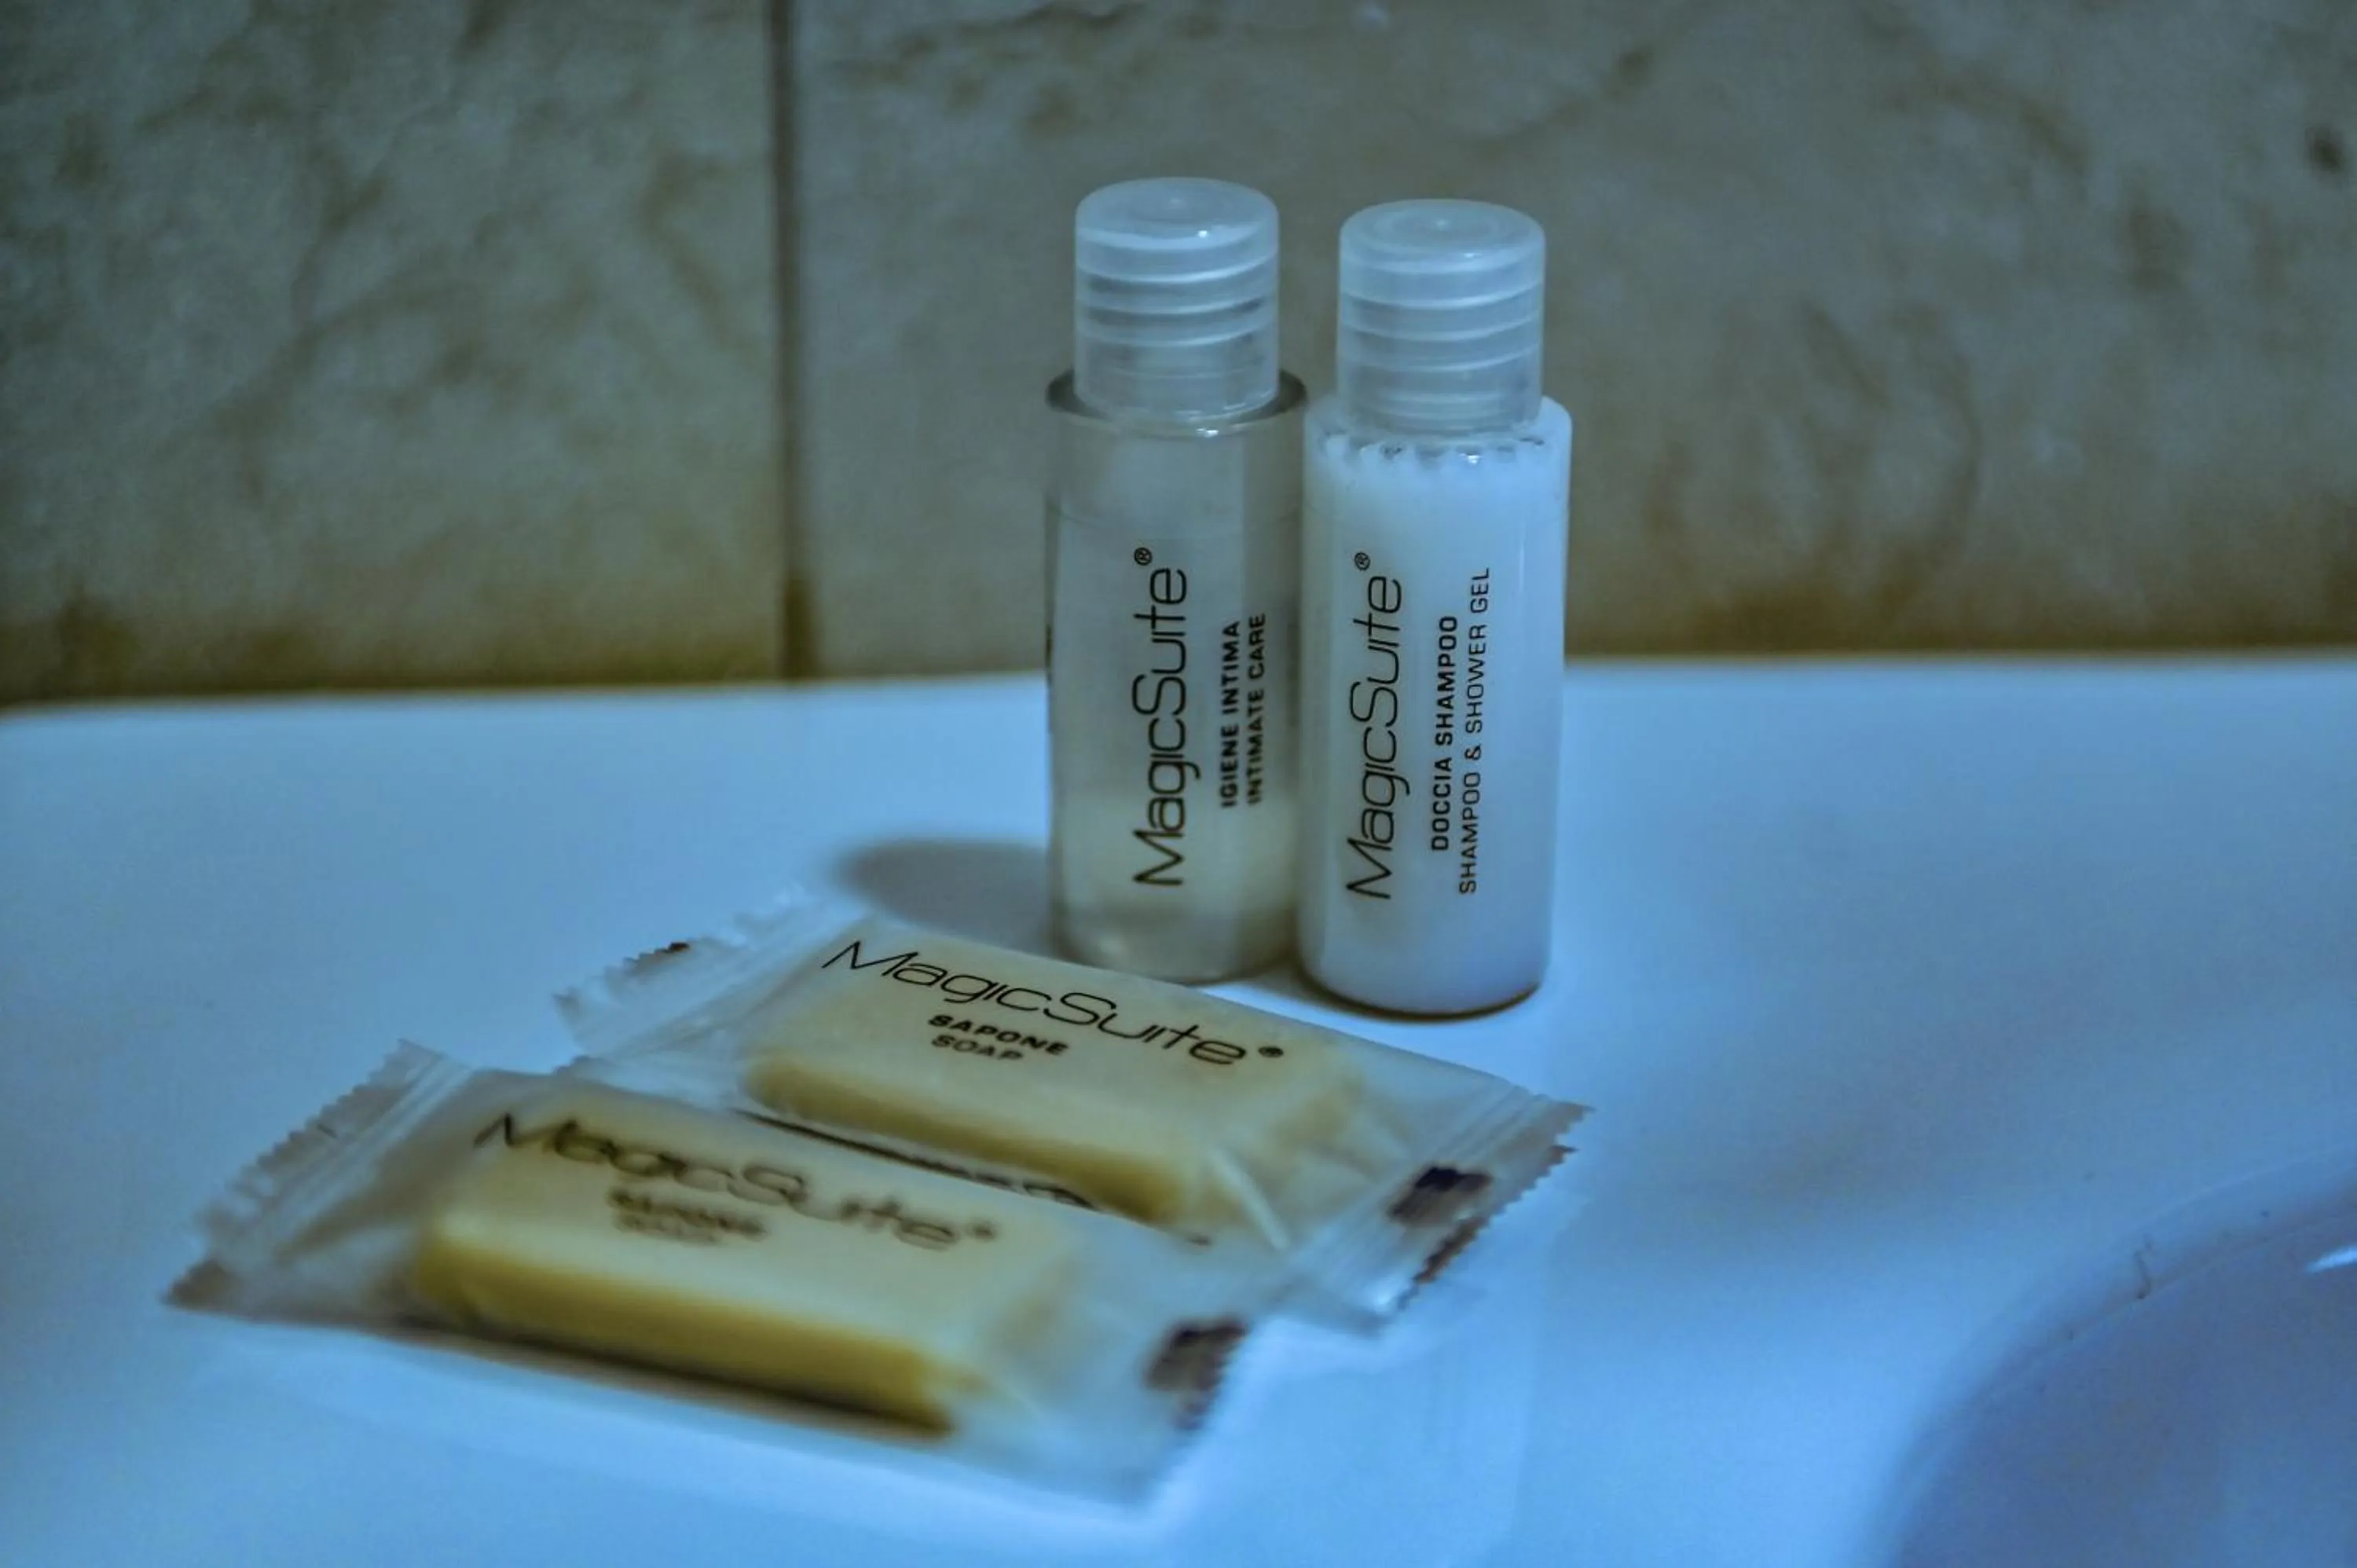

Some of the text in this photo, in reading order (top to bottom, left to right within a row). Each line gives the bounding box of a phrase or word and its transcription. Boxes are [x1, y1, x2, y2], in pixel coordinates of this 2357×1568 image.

[1220, 621, 1240, 808] IGIENE INTIMA
[1246, 613, 1265, 805] INTIMATE CARE
[1431, 616, 1458, 851] DOCCIA SHAMPOO
[1460, 567, 1490, 894] SHAMPOO & SHOWER GEL
[928, 1014, 1069, 1055] SAPONE
[932, 1035, 1023, 1061] SOAP
